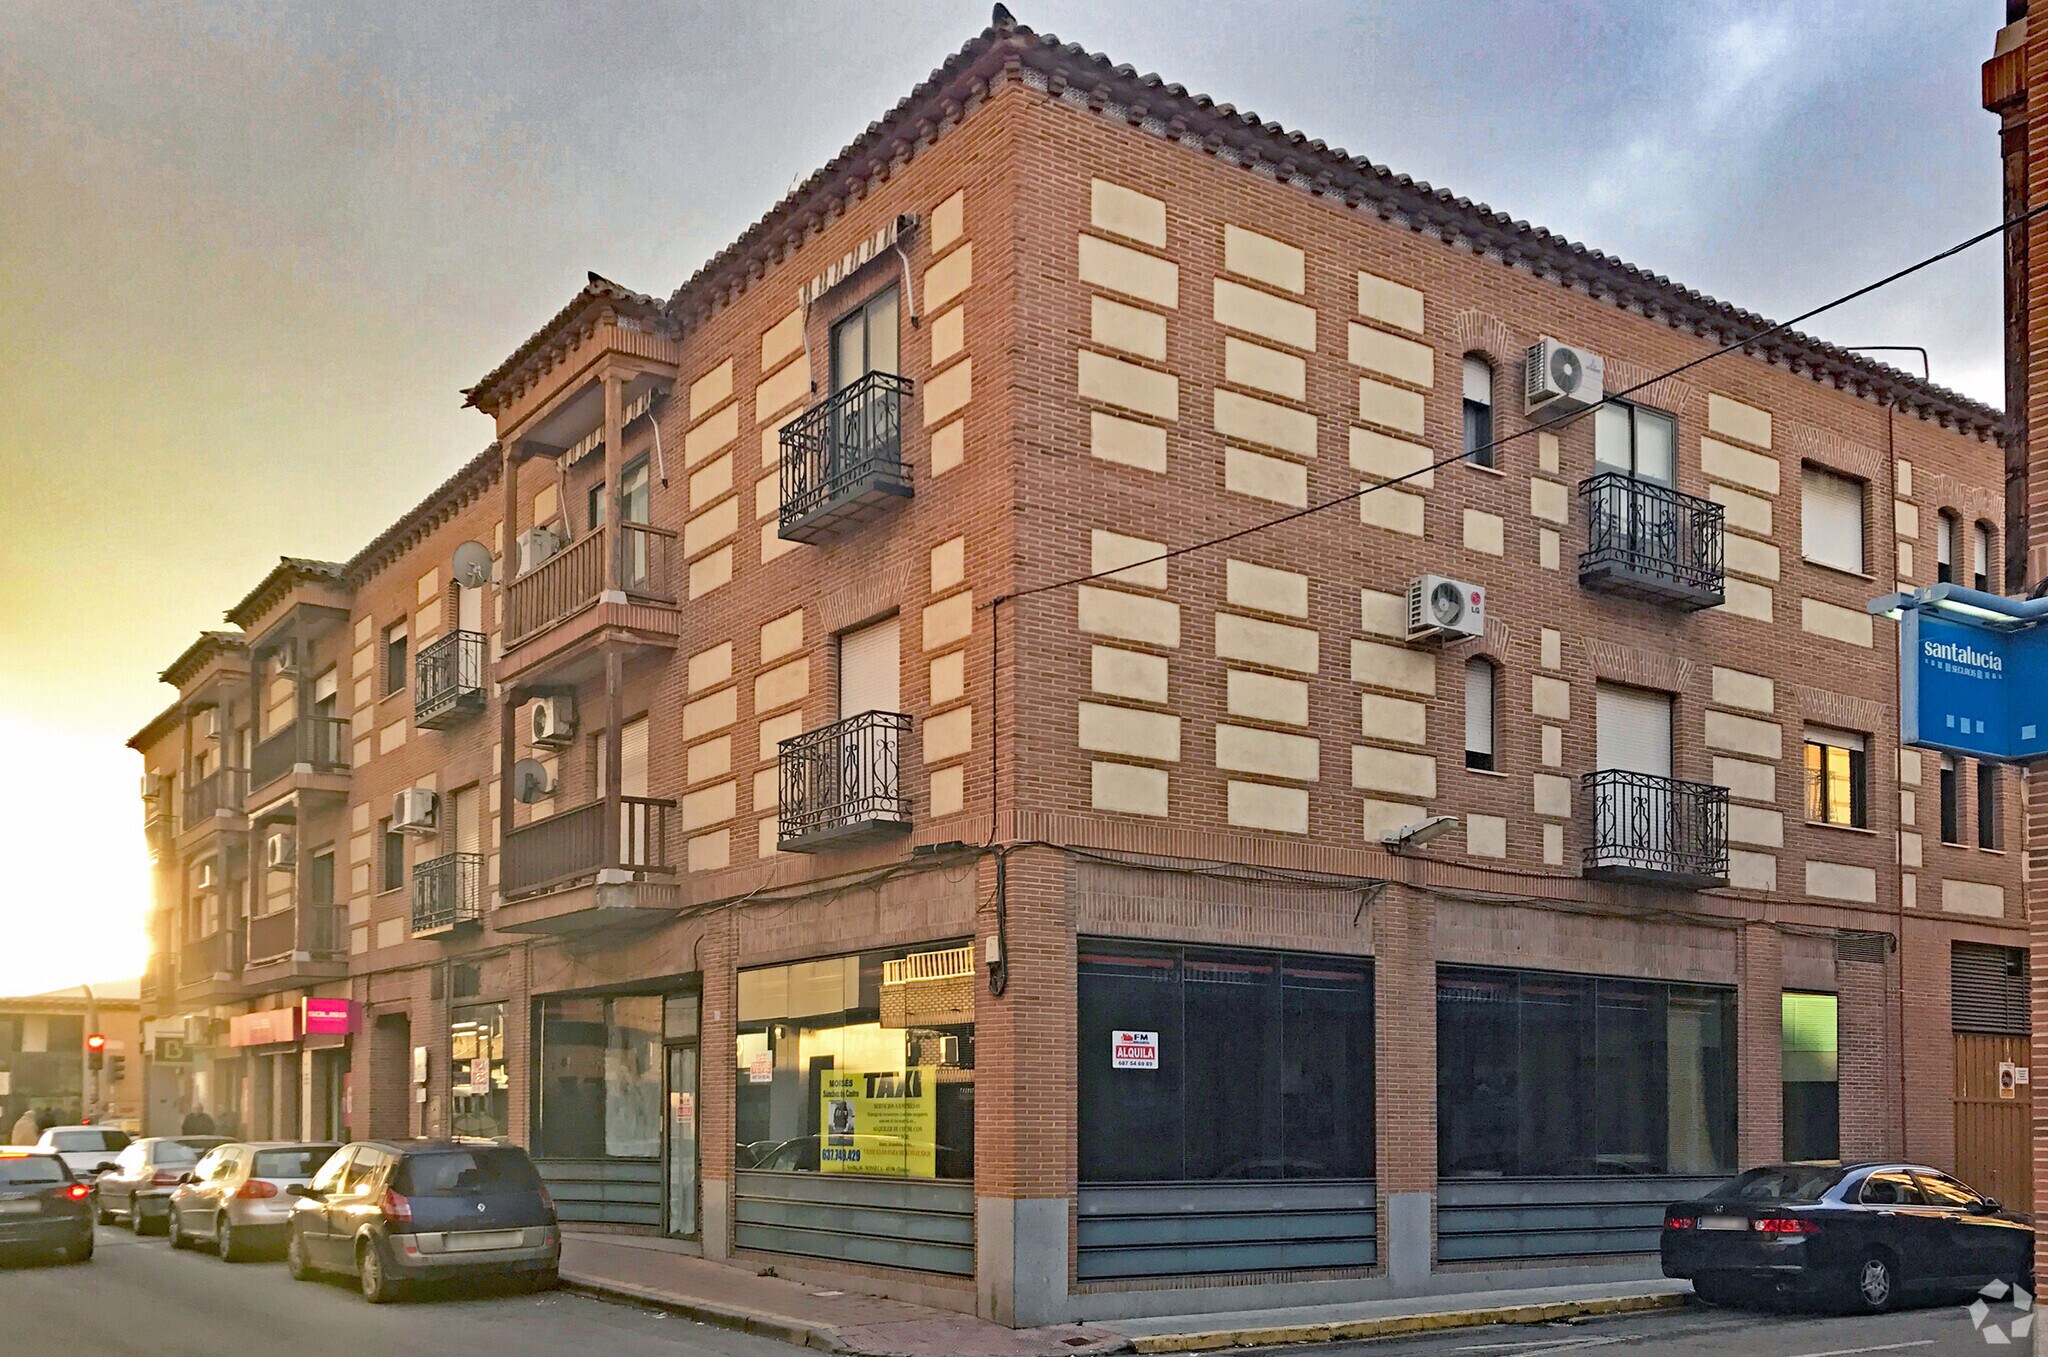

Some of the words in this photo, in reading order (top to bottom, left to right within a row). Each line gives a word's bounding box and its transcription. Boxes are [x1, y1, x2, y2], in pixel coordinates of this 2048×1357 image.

[1471, 606, 1480, 614] LG
[1924, 640, 2002, 672] santalucía
[1951, 664, 1977, 677] SEGUROS
[1117, 1046, 1154, 1059] ALQUILA
[863, 1070, 922, 1099] TAXI
